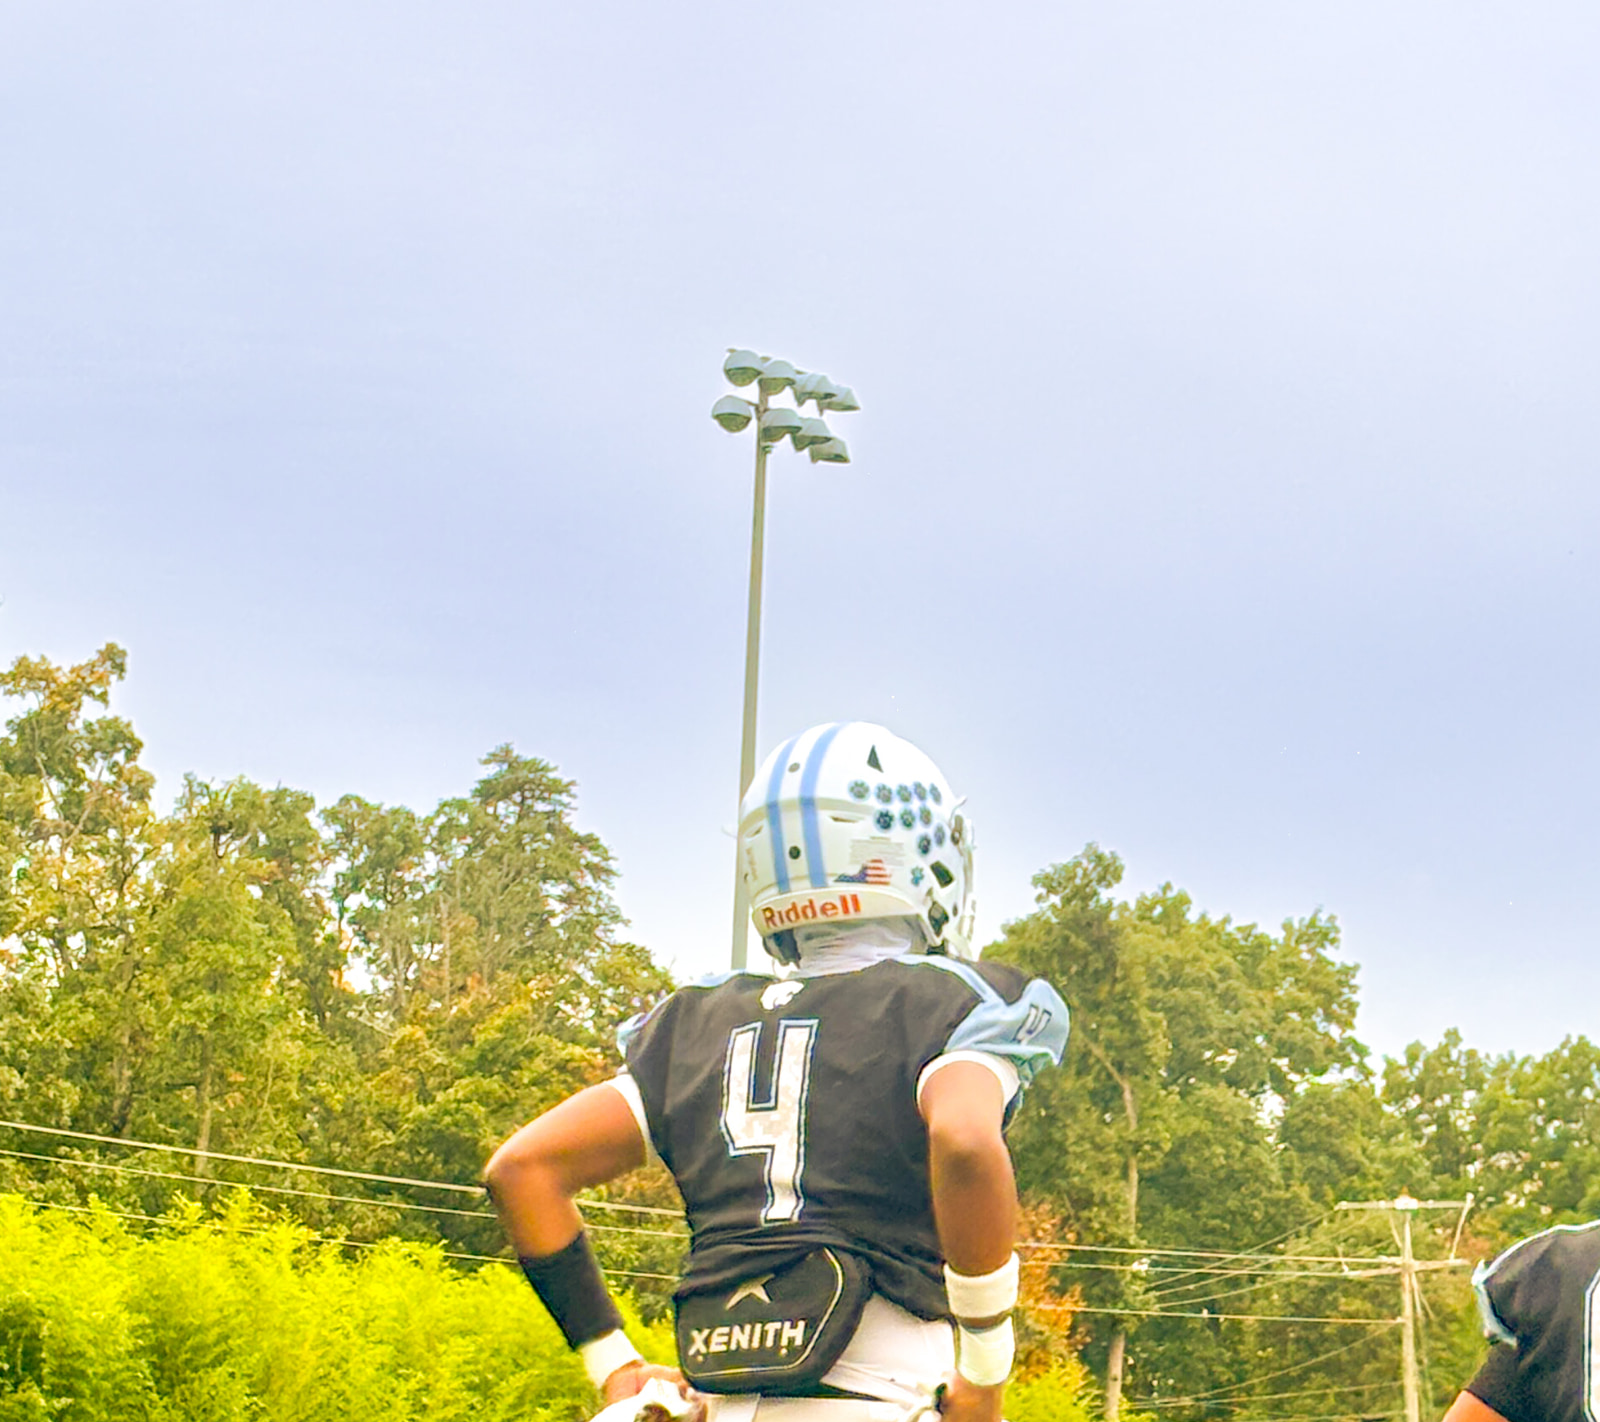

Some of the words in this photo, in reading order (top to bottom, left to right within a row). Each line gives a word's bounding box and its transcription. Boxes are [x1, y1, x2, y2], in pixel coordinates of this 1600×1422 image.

[762, 894, 861, 928] Riddell
[720, 1019, 819, 1226] 4
[688, 1320, 806, 1356] XENITH
